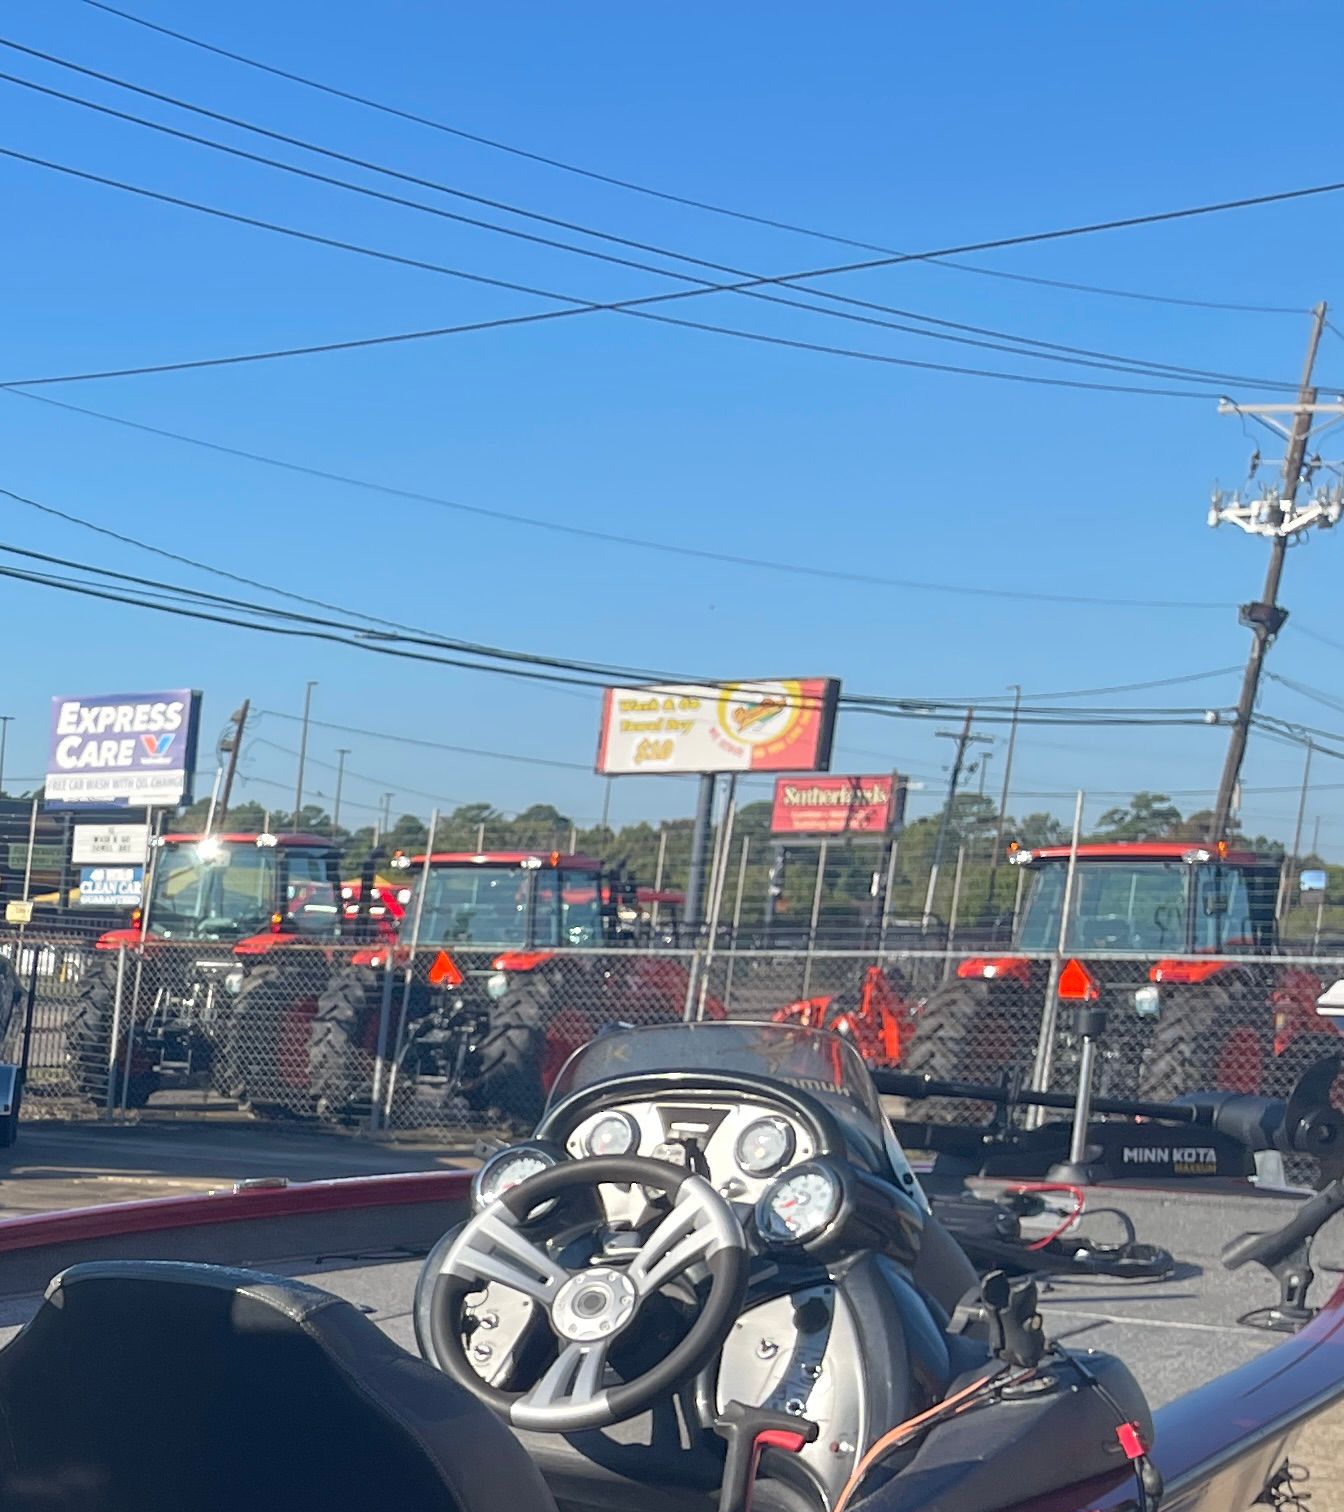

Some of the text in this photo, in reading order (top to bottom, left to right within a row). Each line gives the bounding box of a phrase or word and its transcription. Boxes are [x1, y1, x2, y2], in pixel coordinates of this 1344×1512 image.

[57, 702, 184, 735] EXPRESS
[55, 735, 136, 769] CARE
[80, 880, 142, 895] CLEAN CAR
[1122, 1146, 1217, 1164] MINN KOTA
